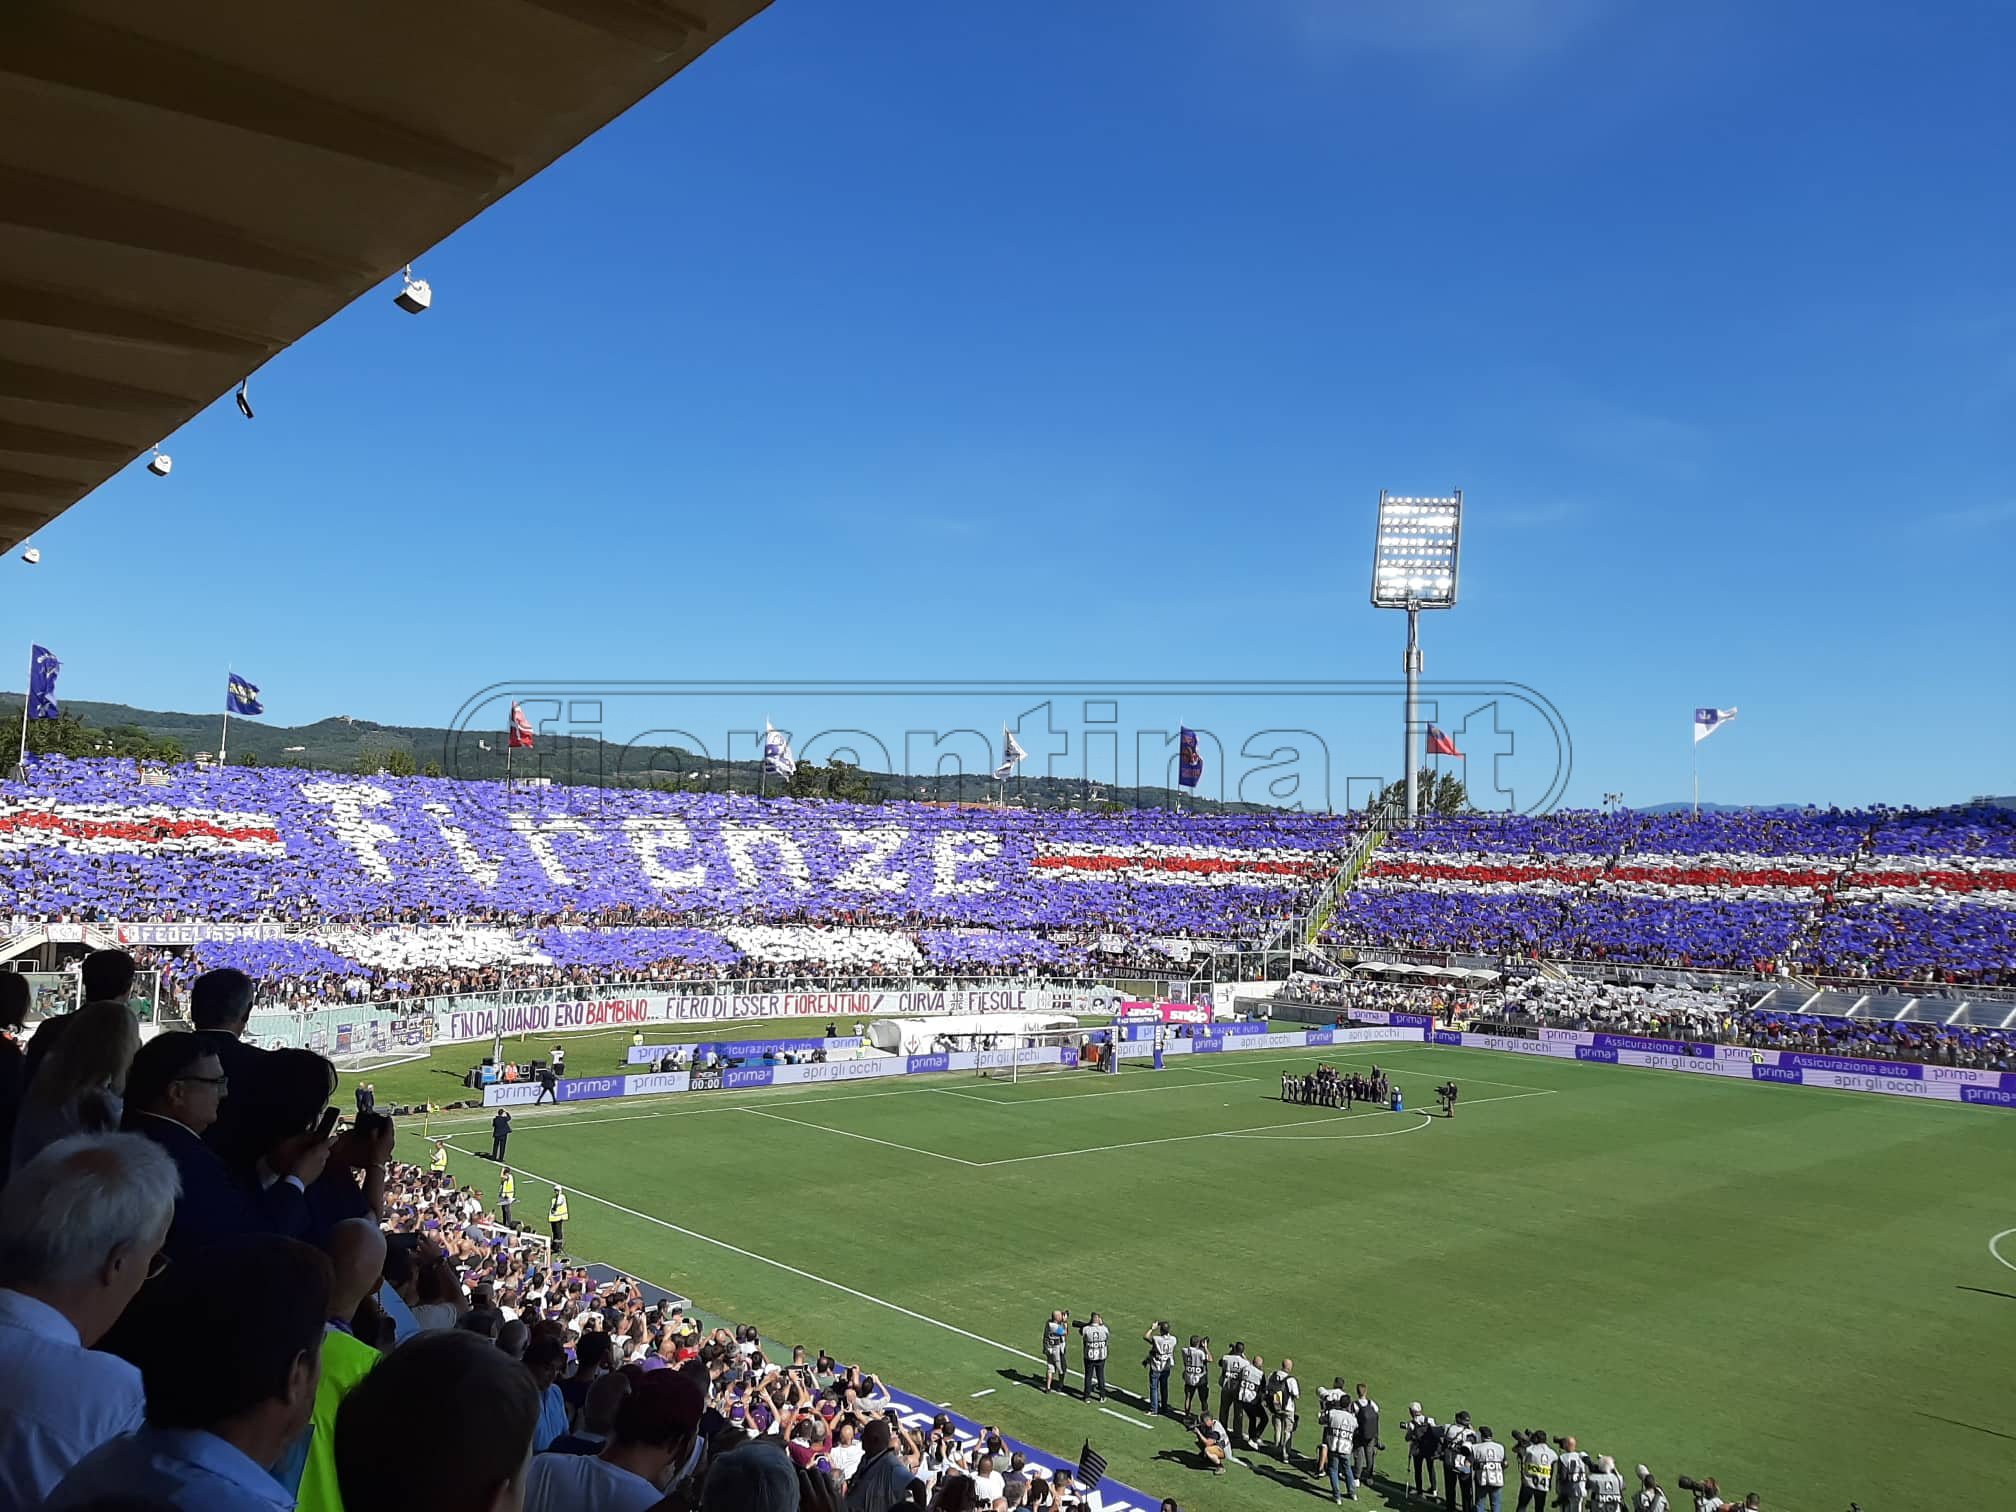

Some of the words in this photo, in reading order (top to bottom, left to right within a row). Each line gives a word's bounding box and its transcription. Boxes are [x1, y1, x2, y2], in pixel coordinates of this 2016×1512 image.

[900, 992, 945, 1012] CURVA
[476, 1010, 496, 1036] DA
[555, 1002, 583, 1027] ERO
[733, 995, 779, 1016] ESSER
[1354, 1009, 1381, 1020] prima
[1396, 1014, 1422, 1026] prima
[1308, 1030, 1329, 1043] prima
[1349, 1030, 1364, 1040] apri
[1377, 1027, 1400, 1038] occhi
[1427, 1032, 1455, 1043] prima
[1546, 1030, 1578, 1042] prima
[832, 1037, 862, 1049] prim
[1195, 1038, 1217, 1049] prima
[1241, 1037, 1256, 1048] apri
[1269, 1034, 1291, 1045] occhi
[1484, 1037, 1505, 1048] apri
[1508, 1037, 1520, 1050] gli
[1523, 1039, 1551, 1052] occhi
[1605, 1036, 1675, 1053] Assicurazione
[1580, 1047, 1611, 1059] prima
[803, 1066, 827, 1080] apri
[831, 1063, 847, 1077] gli
[850, 1059, 882, 1074] occhi
[911, 1058, 941, 1071] prima
[1645, 1054, 1668, 1068] apri
[1672, 1056, 1686, 1070] gli
[1690, 1057, 1724, 1072] occhi
[1792, 1056, 1877, 1074] Assicurazione
[1880, 1065, 1909, 1077] auto
[728, 1071, 764, 1086] prima
[1759, 1067, 1794, 1082] prima
[1933, 1069, 1977, 1082] prima
[566, 1080, 611, 1099] prima
[633, 1075, 674, 1093] prima
[691, 1079, 720, 1090] 00:00
[1834, 1074, 1862, 1087] apri
[1866, 1077, 1882, 1091] gli
[1887, 1078, 1927, 1094] occhi
[493, 1085, 541, 1103] prima
[1967, 1089, 2009, 1102] prima
